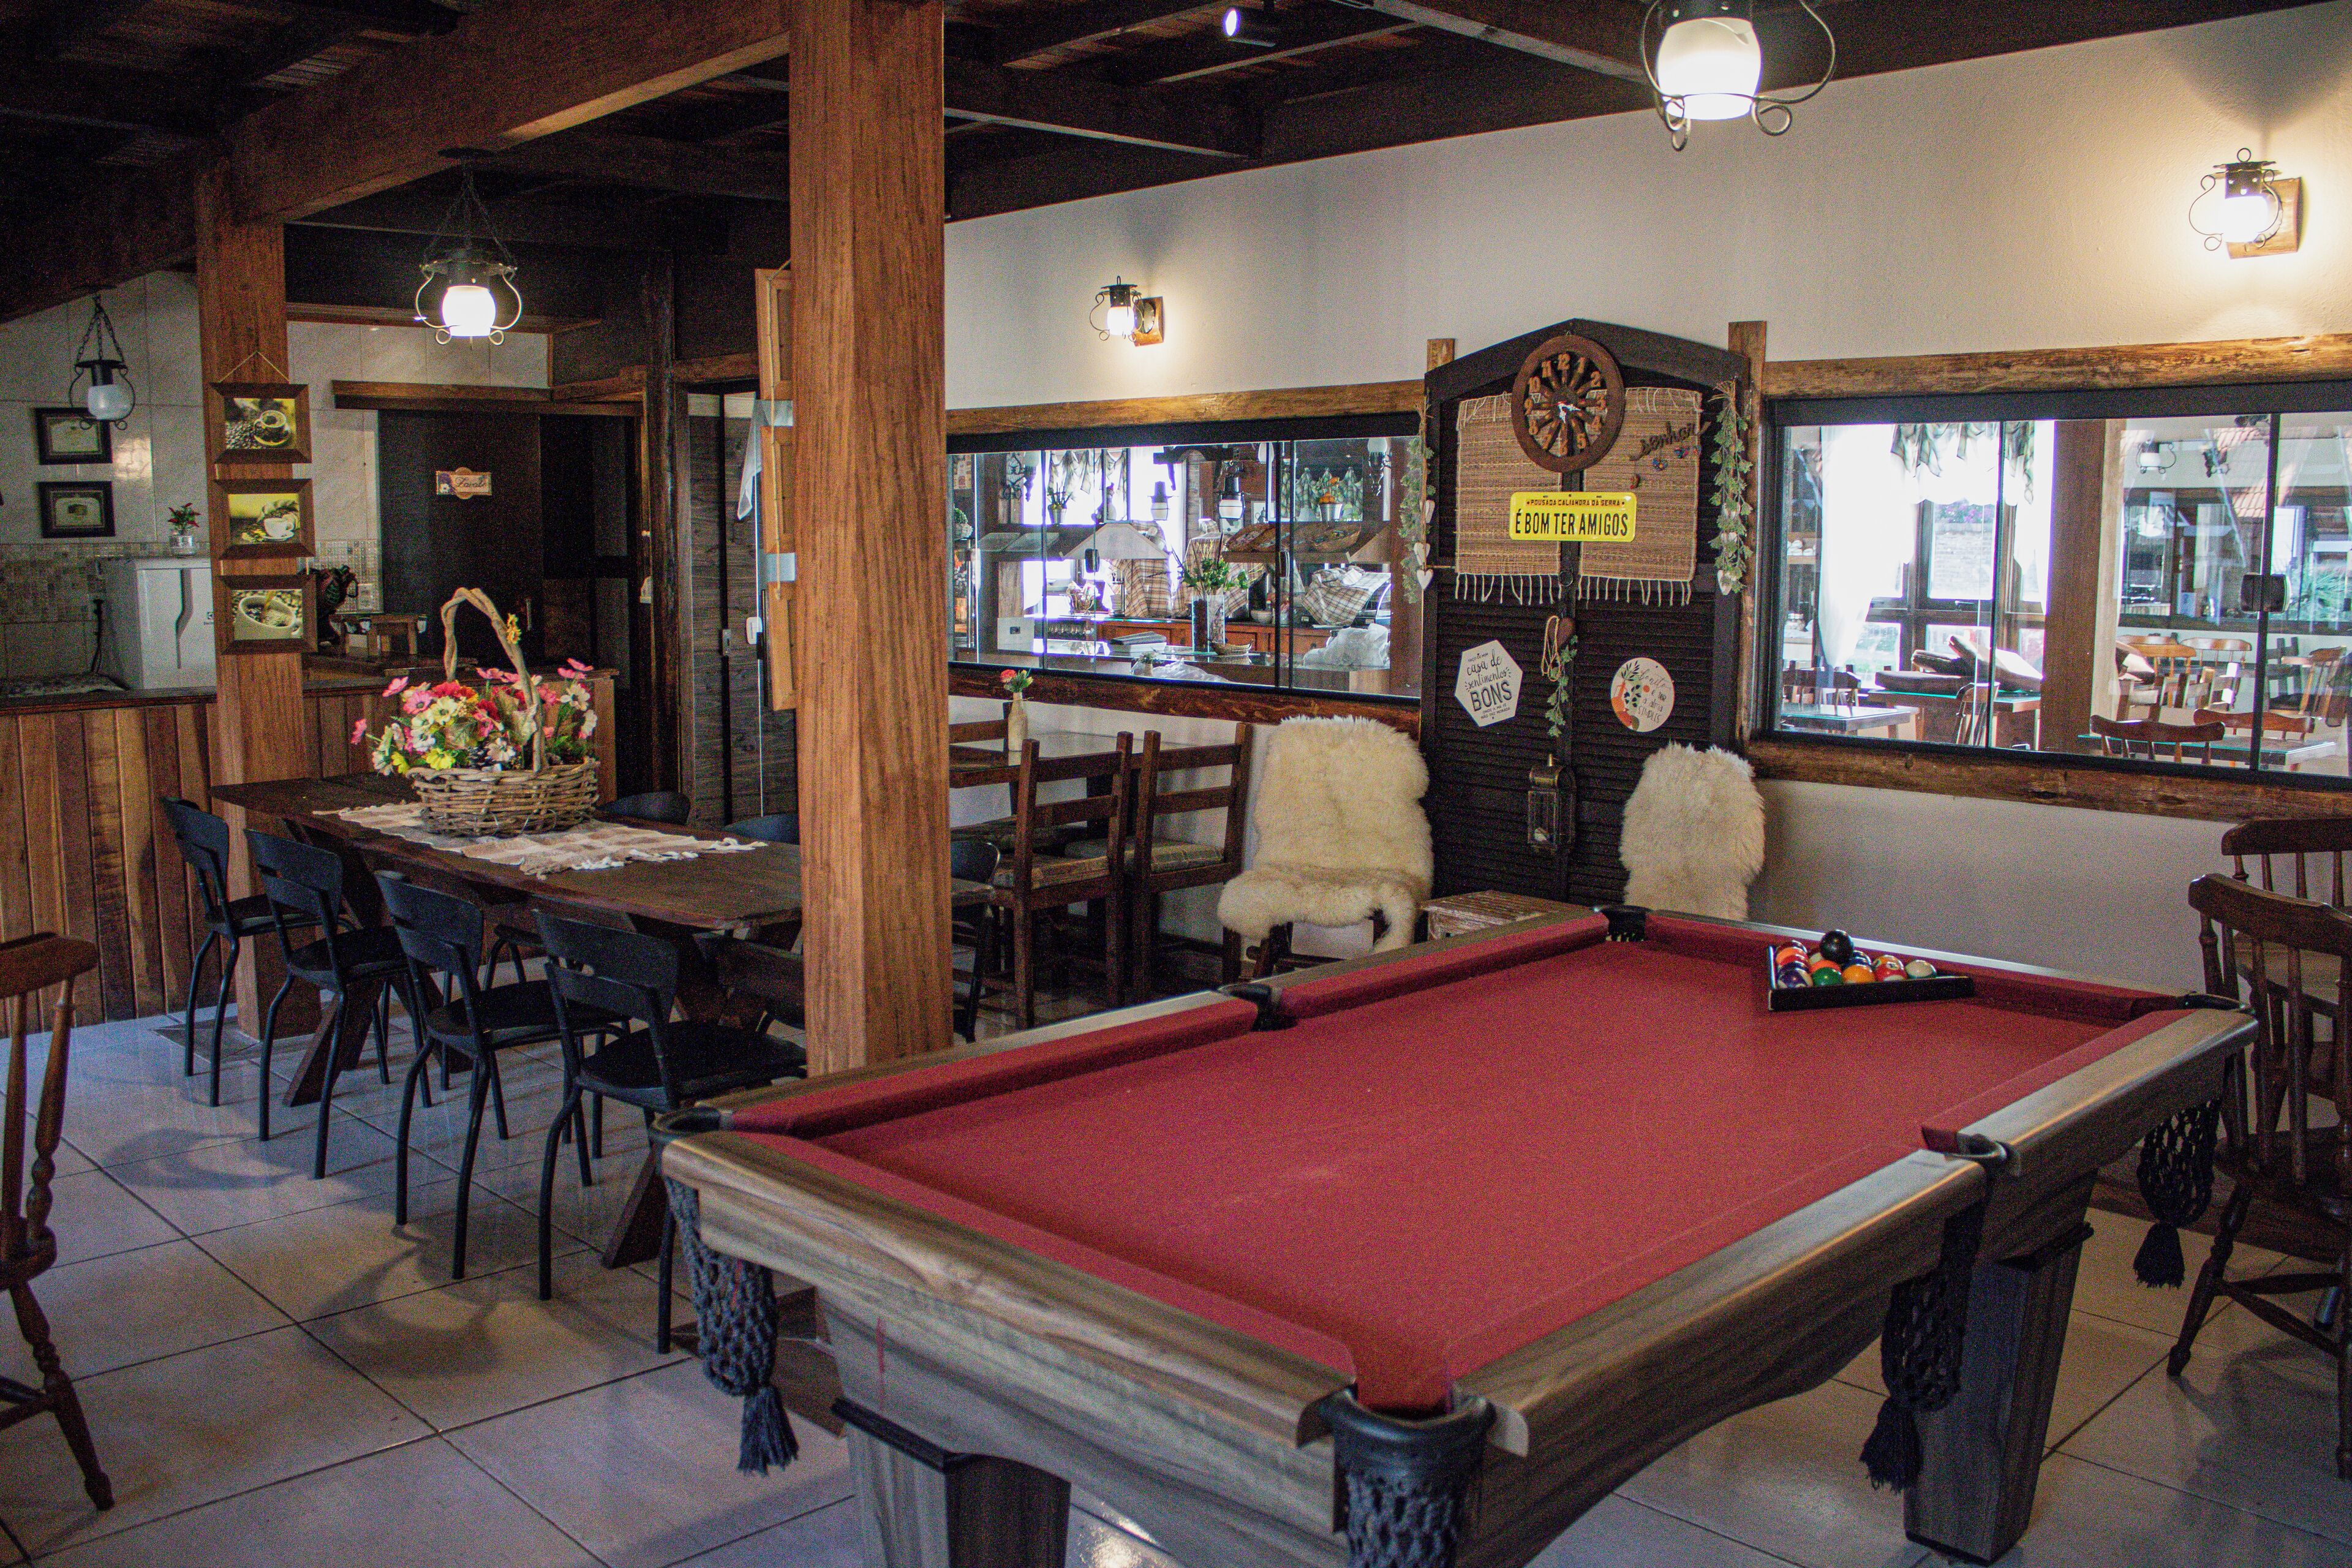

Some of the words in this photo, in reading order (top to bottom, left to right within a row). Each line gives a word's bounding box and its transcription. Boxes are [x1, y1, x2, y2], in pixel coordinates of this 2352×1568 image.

[1558, 353, 1570, 370] 12
[1591, 371, 1601, 386] 2
[1577, 432, 1586, 449] 5
[1515, 508, 1521, 534] É
[1525, 513, 1550, 534] BOM
[1554, 513, 1575, 535] TER
[1579, 513, 1628, 536] AMIGOS
[1467, 661, 1488, 676] casa
[1491, 649, 1502, 666] de
[1468, 666, 1507, 689] sentimentos
[1470, 681, 1512, 711] BONS
